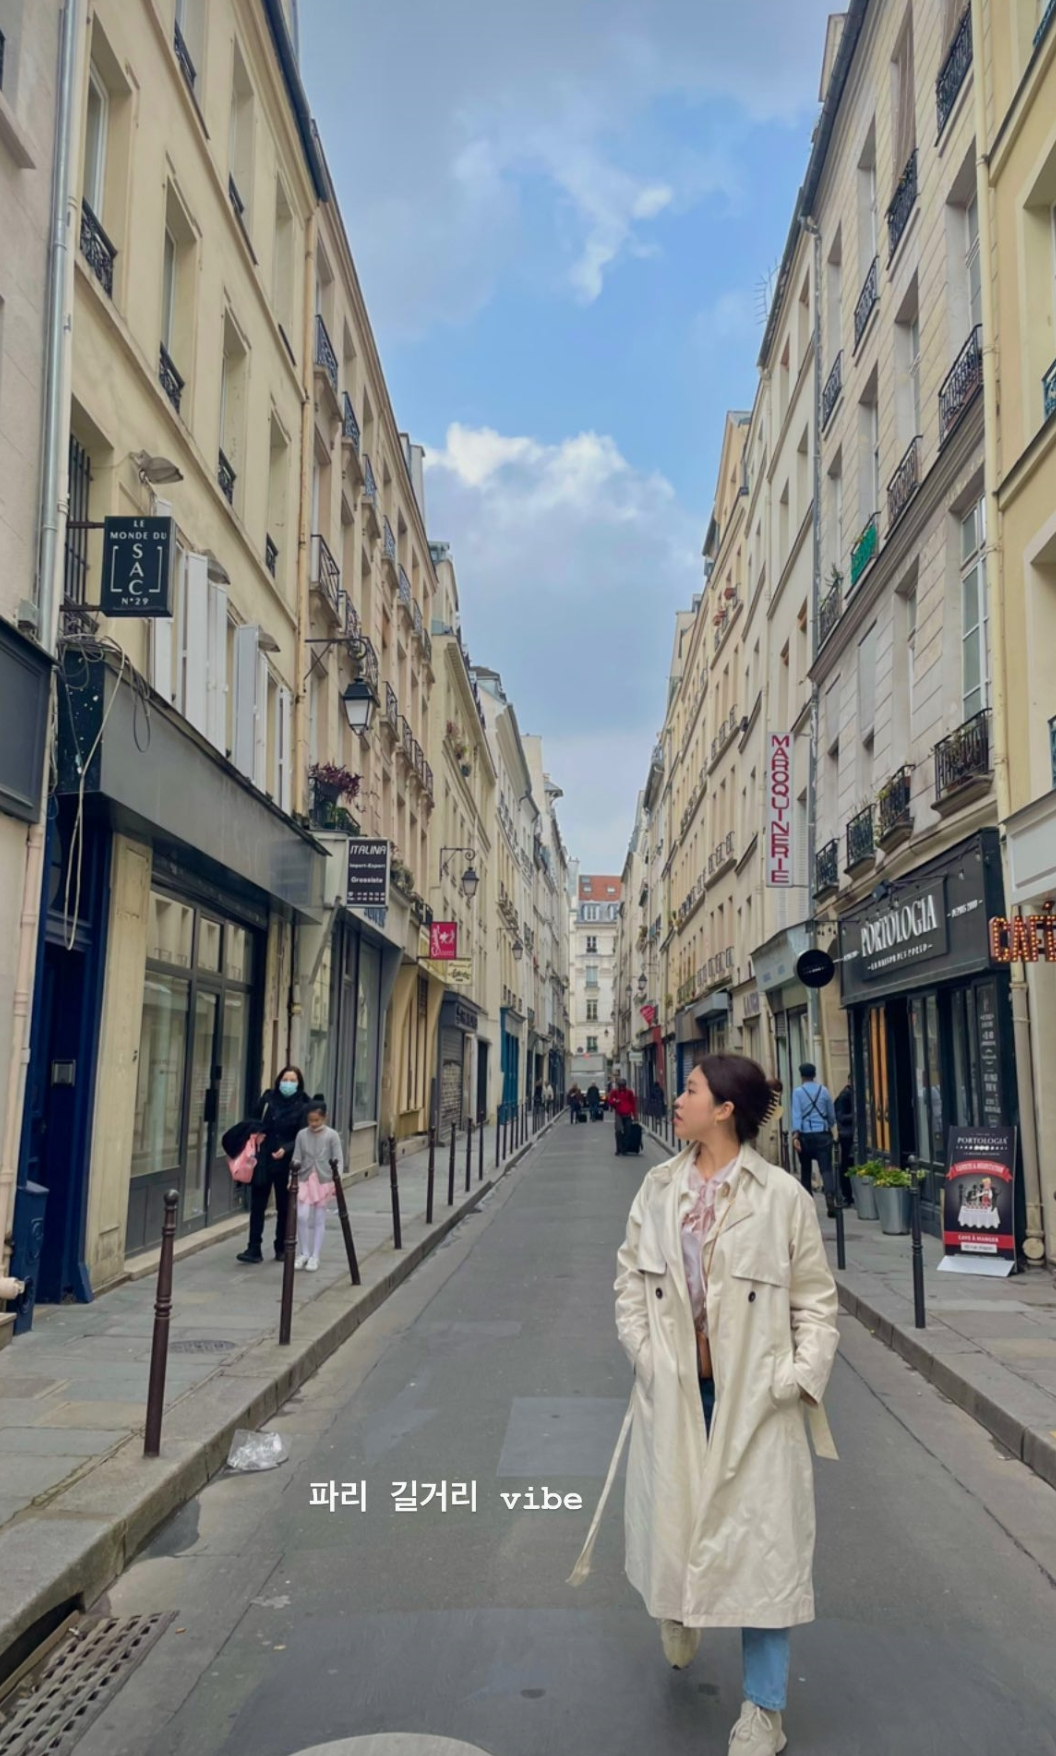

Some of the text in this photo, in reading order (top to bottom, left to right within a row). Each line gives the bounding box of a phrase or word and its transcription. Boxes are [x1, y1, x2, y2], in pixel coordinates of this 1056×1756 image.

[133, 519, 145, 528] LE
[110, 531, 167, 540] MONDE DU
[128, 542, 145, 596] SAC
[771, 734, 790, 884] MAROQUINERIE
[350, 844, 387, 855] ITALINA
[860, 894, 938, 958] PORTOLOGIA
[957, 1135, 1008, 1145] PORTOLOGIA
